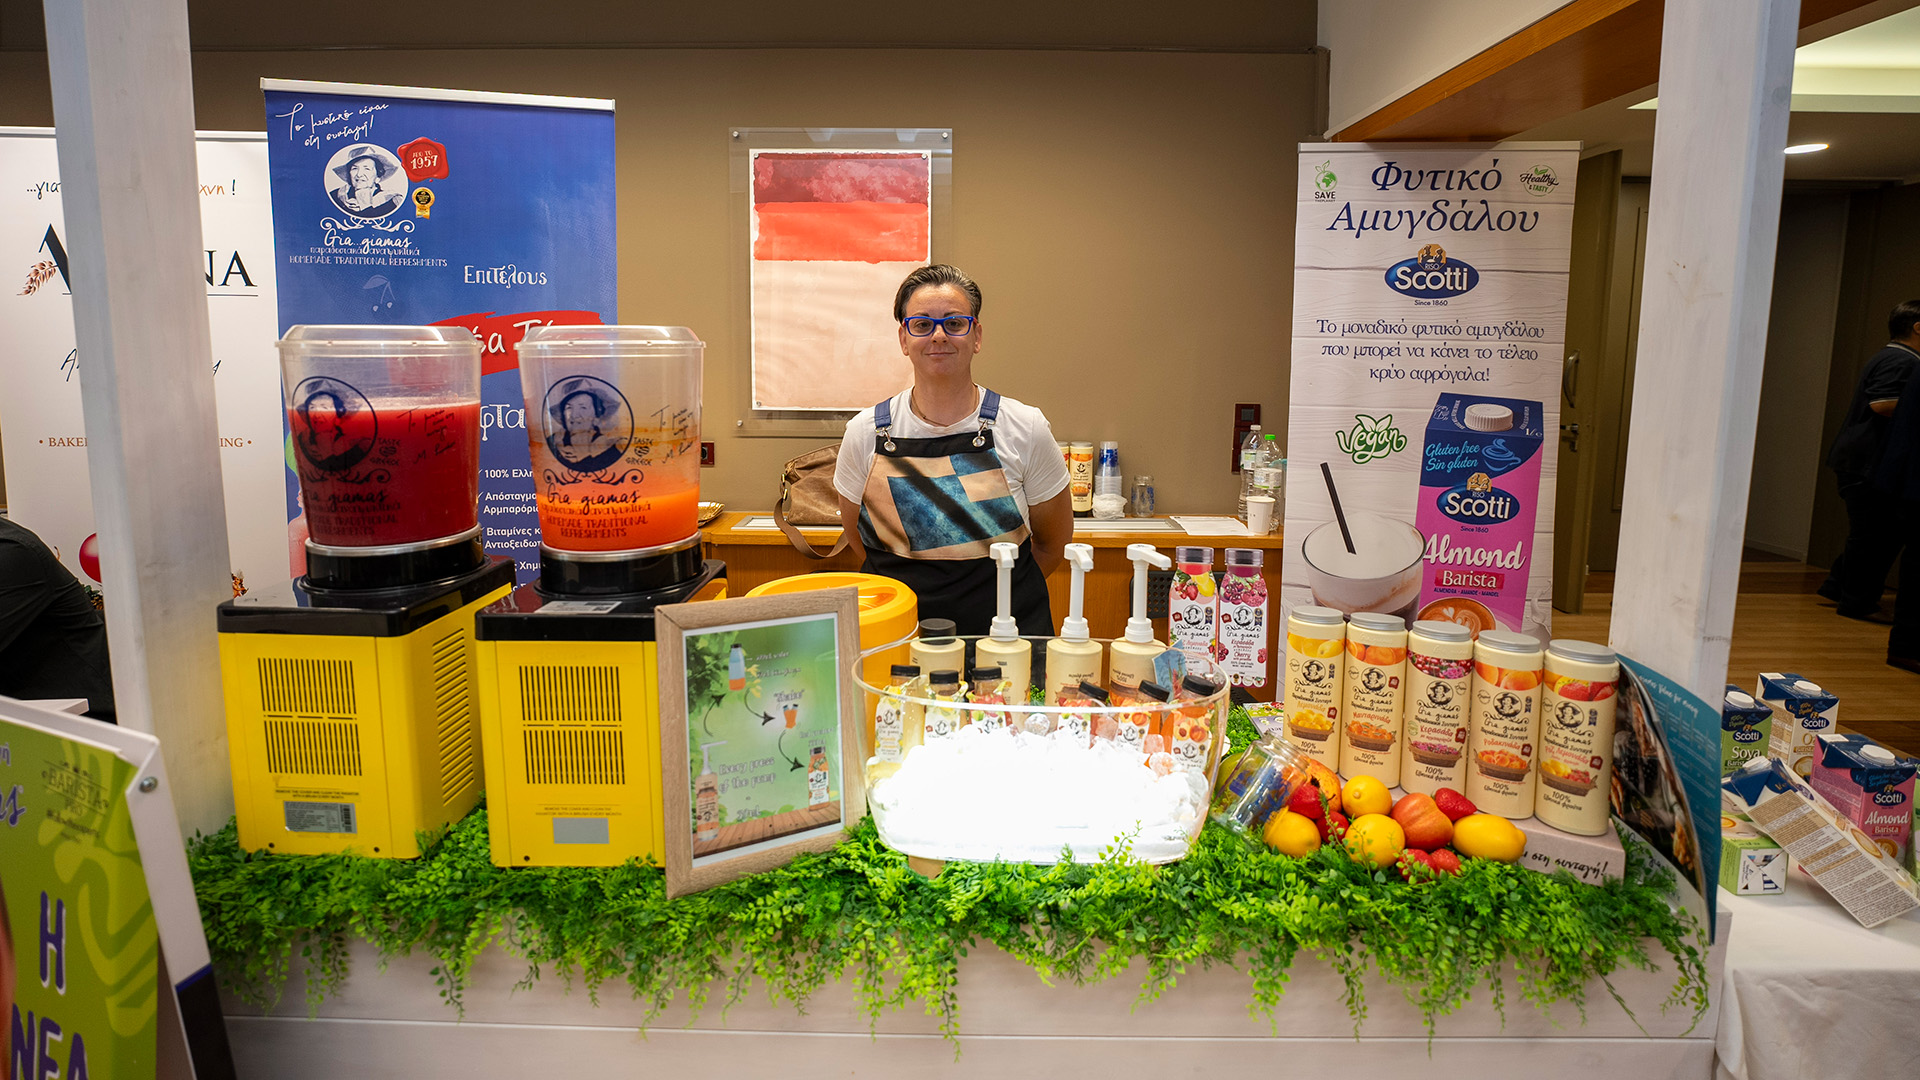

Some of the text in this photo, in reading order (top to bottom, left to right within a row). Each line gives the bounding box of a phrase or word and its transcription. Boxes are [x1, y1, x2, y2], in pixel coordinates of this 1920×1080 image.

[410, 154, 438, 169] 1957
[1371, 158, 1503, 192] Φυτικό
[1519, 173, 1559, 187] Healthy
[1314, 191, 1336, 199] SAVE
[1326, 199, 1540, 239] Αμυγδάλου
[289, 255, 448, 267] HOMEMADE TRADITIONAL REFRESHMENTS
[1424, 262, 1440, 271] RISO
[464, 264, 548, 289] Επιτέλους
[1394, 266, 1468, 291] Scotti
[1317, 318, 1545, 340] Το μοναδικό φυτικό αμυγδάλου
[1322, 341, 1539, 361] που μπορεί να κάνει το τέλειο
[1369, 363, 1490, 384] κρύο αφρόγαλα!
[48, 437, 88, 447] BAKE
[1335, 414, 1408, 464] Vegan
[1425, 440, 1481, 458] Gluten free
[1425, 456, 1479, 474] Sin gluten
[484, 469, 509, 478] 100%
[580, 488, 642, 516] giamas
[1444, 493, 1511, 520] Scotti
[586, 515, 649, 528] TRADITIONAL
[486, 527, 532, 538] Βιταμίνες
[1475, 526, 1489, 534] 1860
[1424, 533, 1527, 570] Almond
[1441, 570, 1497, 588] Barista
[1309, 689, 1331, 698] giamas
[1370, 697, 1393, 706] giamas
[1436, 712, 1459, 721] giamas
[1803, 719, 1827, 728] Scotti
[1420, 725, 1453, 737] Κερασάδα
[1735, 732, 1760, 741] Scotti
[1301, 741, 1316, 749] 100%
[1563, 736, 1592, 745] giamas
[1361, 752, 1376, 760] 100%
[1731, 746, 1760, 760] Soya
[719, 757, 775, 776] Every press
[1425, 766, 1443, 776] 100%
[731, 777, 749, 788] the
[751, 772, 776, 788] pump
[1493, 782, 1509, 790] 100%
[1551, 791, 1571, 803] 100%
[1875, 793, 1902, 803] Scotti
[1864, 811, 1908, 825] Almond
